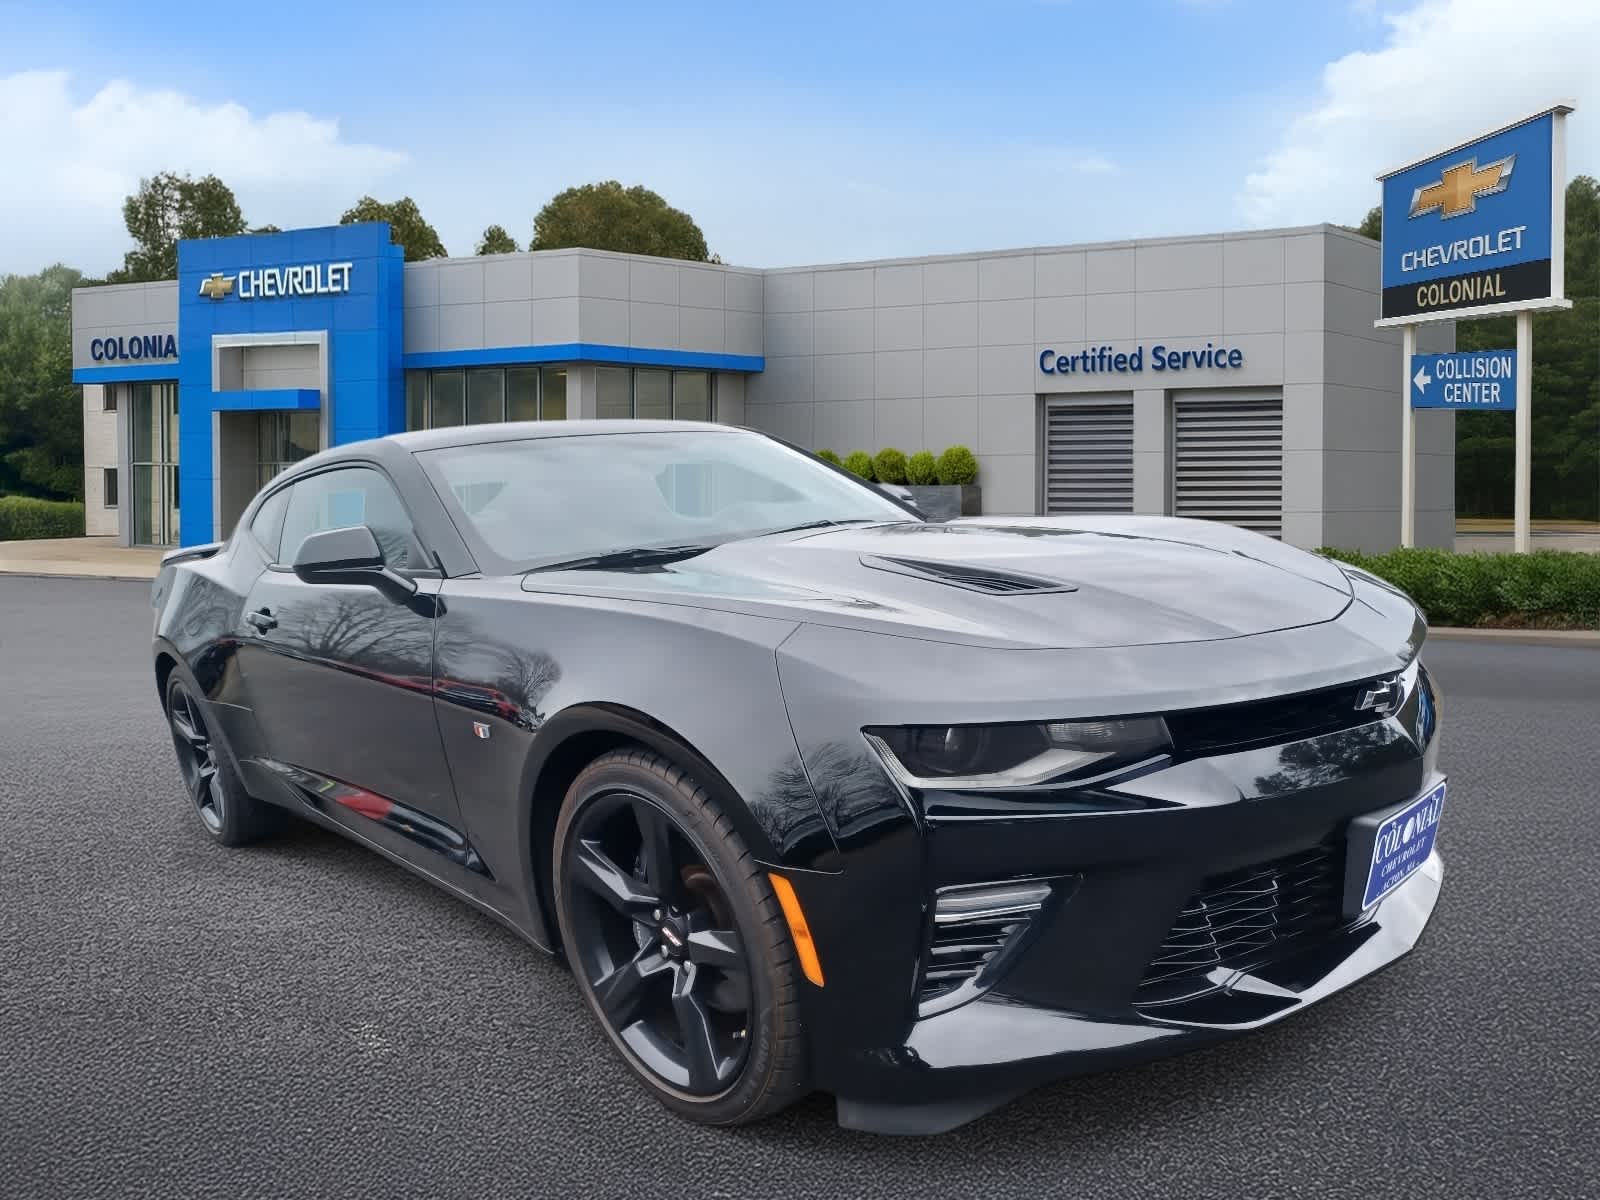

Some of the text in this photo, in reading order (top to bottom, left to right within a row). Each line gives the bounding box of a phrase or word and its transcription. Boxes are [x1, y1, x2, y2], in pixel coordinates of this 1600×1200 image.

[1401, 225, 1528, 273] CHEVROLET
[238, 262, 353, 299] CHEVROLET
[1416, 273, 1506, 308] COLONIAL
[1039, 343, 1243, 375] Certified Service
[1436, 356, 1512, 380] COLLISION
[1444, 382, 1501, 404] CENTER
[1375, 797, 1441, 864] COLONIAL
[1382, 836, 1427, 878] CHEVROLET
